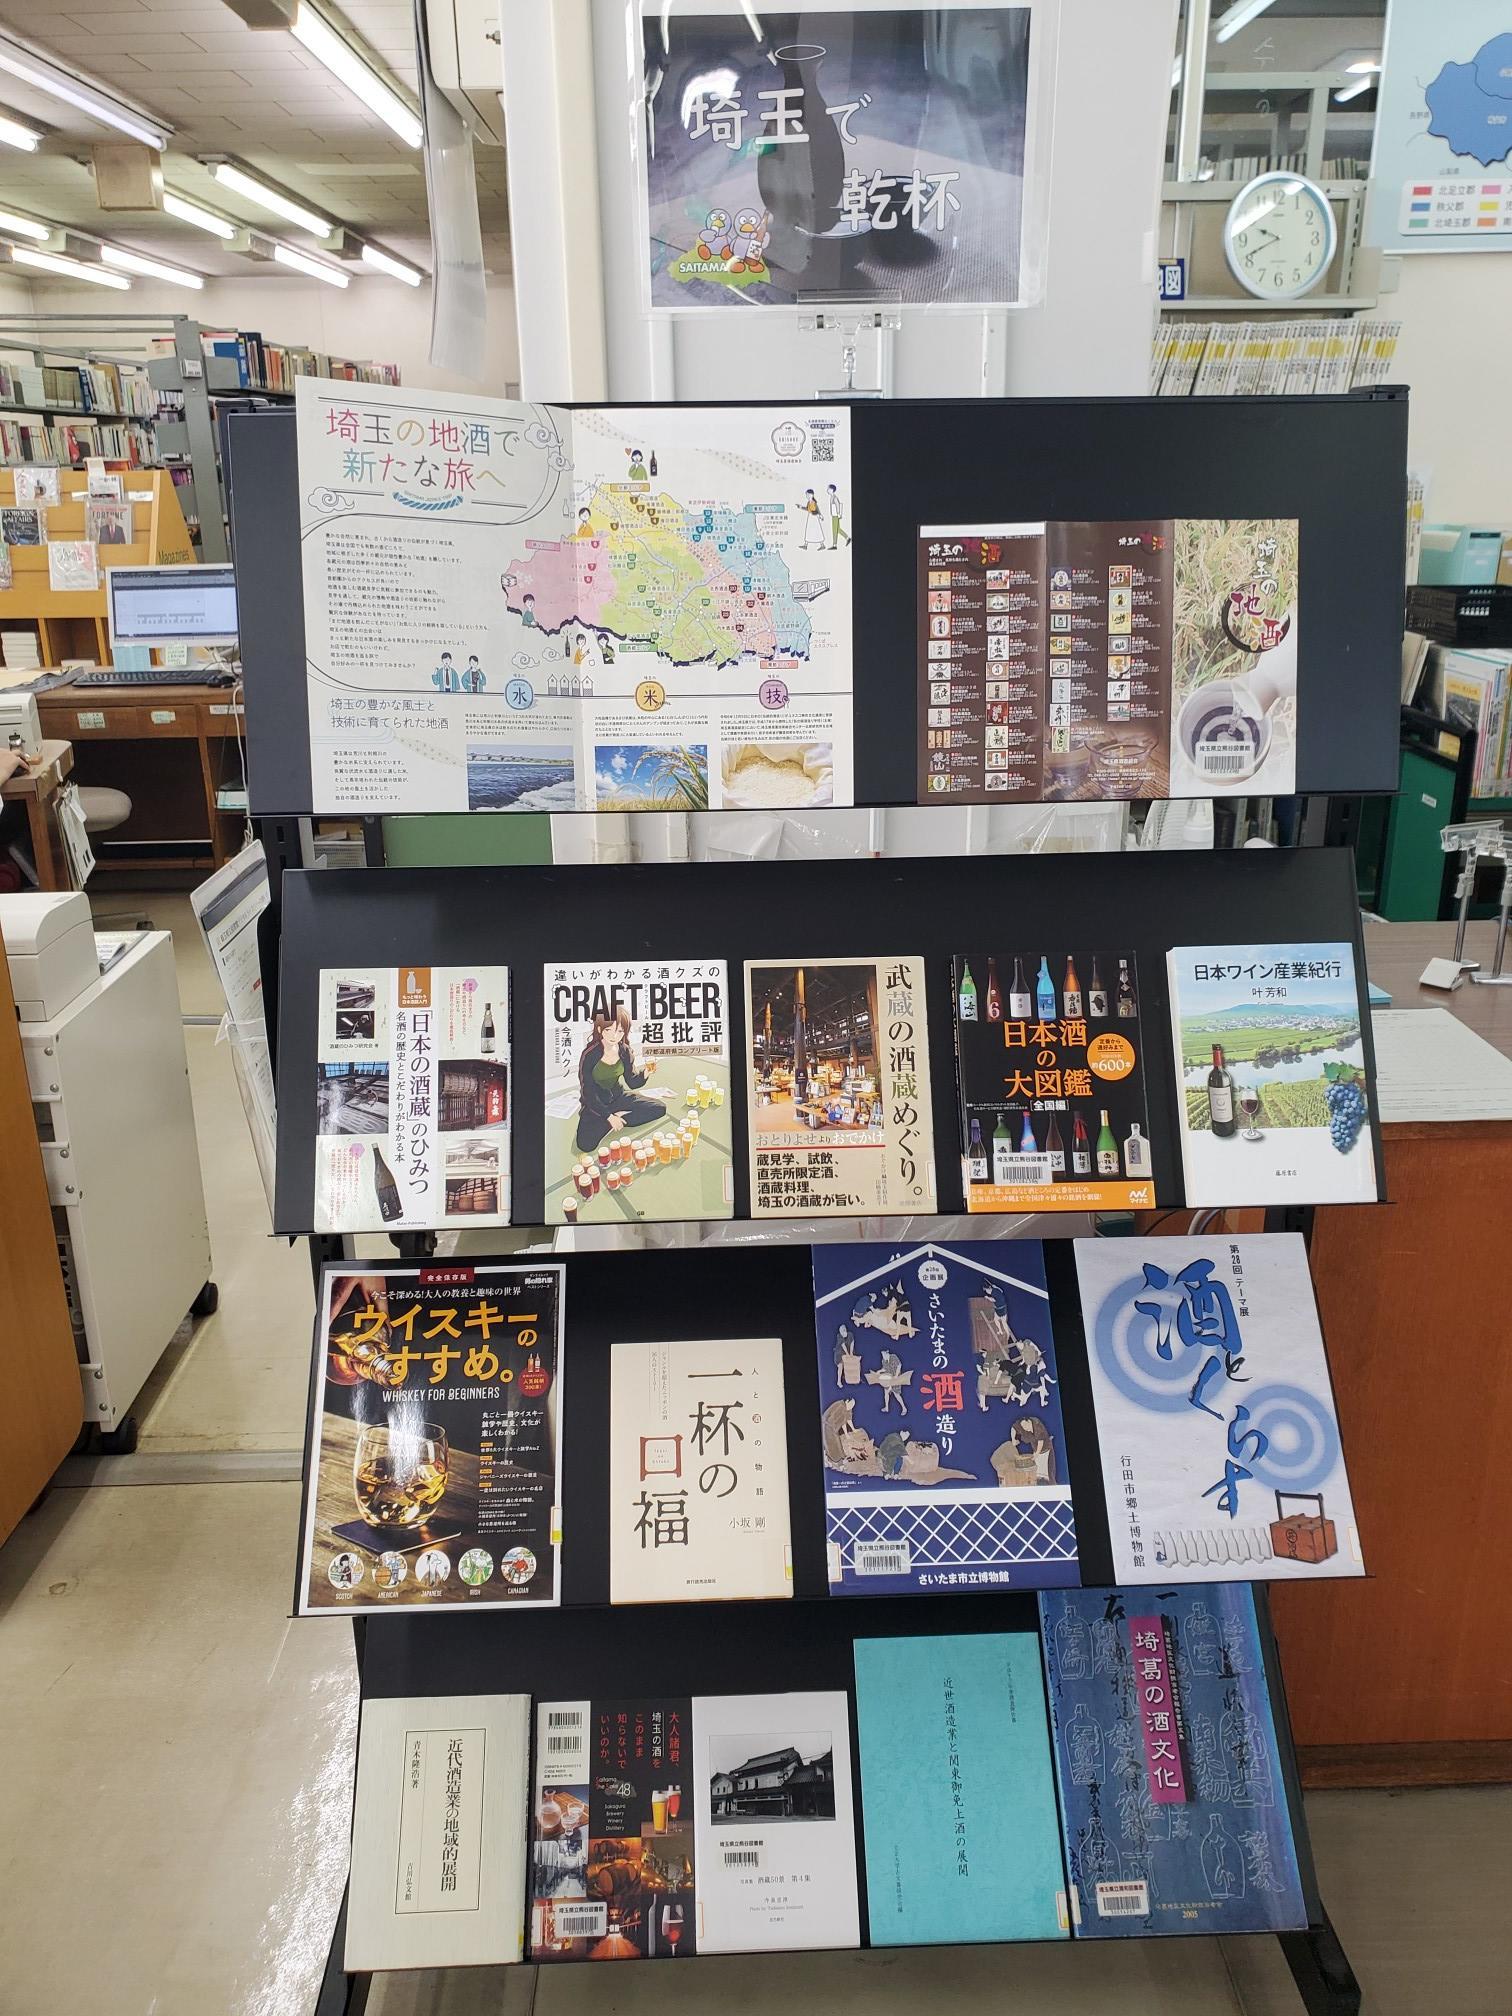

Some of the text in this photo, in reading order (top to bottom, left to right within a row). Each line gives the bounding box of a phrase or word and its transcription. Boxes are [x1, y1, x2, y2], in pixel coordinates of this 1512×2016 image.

[689, 88, 871, 150] 埼玉で
[1439, 185, 1475, 195] 北足立郡
[840, 168, 960, 231] 乾杯
[1305, 210, 1313, 225] 2
[1239, 233, 1247, 248] 9
[1311, 231, 1319, 246] 3
[1245, 254, 1254, 268] 8
[1305, 252, 1312, 265] 4
[679, 262, 728, 273] SAITAMA
[1258, 268, 1266, 282] 7
[1293, 268, 1300, 281] 5
[1274, 272, 1283, 287] 6
[325, 407, 520, 457] 埼玉の地酒で
[343, 448, 506, 492] 新たな旅へ
[158, 549, 190, 565] Magazines
[513, 687, 527, 705] 水
[643, 689, 658, 706] 米
[766, 688, 782, 704] 技
[330, 698, 435, 713] 埼玉の豊かな風土と
[332, 715, 449, 730] 技術に育てられた地酒
[554, 967, 720, 981] 違いがわかる酒クズの
[1194, 960, 1342, 981] 日本ワイン産業紀行
[1252, 987, 1287, 998] 叶 芳和
[553, 982, 721, 1023] CRAFT BEER
[641, 1022, 722, 1044] 超批評
[1003, 1019, 1088, 1048] 日本酒
[561, 1026, 572, 1078] 今酒ハクノ
[1036, 1050, 1056, 1067] の
[394, 1010, 407, 1162] 名酒の歴史とこだわりがわかる本
[884, 963, 923, 1197] 武蔵の酒蔵めぐり。
[1004, 1069, 1094, 1098] 大図鑑
[407, 1009, 432, 1195] 「日本の酒蔵」のひみつ
[756, 1152, 840, 1166] 蔵見学、試飲、
[757, 1167, 840, 1180] 直売所限定酒、
[757, 1180, 816, 1194] 酒蔵料理、
[757, 1193, 866, 1208] 埼玉の酒蔵が旨い。
[427, 1274, 468, 1282] 完全保存版
[1229, 1244, 1250, 1318] 第28回 テーマ展
[384, 1345, 514, 1386] すすめ。
[922, 1292, 965, 1456] さいたまの酒造り
[382, 1387, 500, 1403] WHISKEY FOR BEGINNERS
[688, 1369, 745, 1499] 一杯の
[632, 1434, 690, 1549] 口福
[1119, 1455, 1147, 1568] 行田市郷土博物館
[729, 1517, 766, 1528] 小坂 剛
[919, 1571, 1010, 1586] さいたま市立博物館
[1135, 1631, 1180, 1791] 埼葛の酒文化
[651, 1711, 663, 1769] 埼玉の酒を
[411, 1740, 422, 1789] 青木隆浩著
[943, 1676, 969, 1877] 近世酒造業と関東御免上酒の展開
[617, 1783, 631, 1797] 48
[440, 1738, 464, 1893] 近代酒造業の地域的展開
